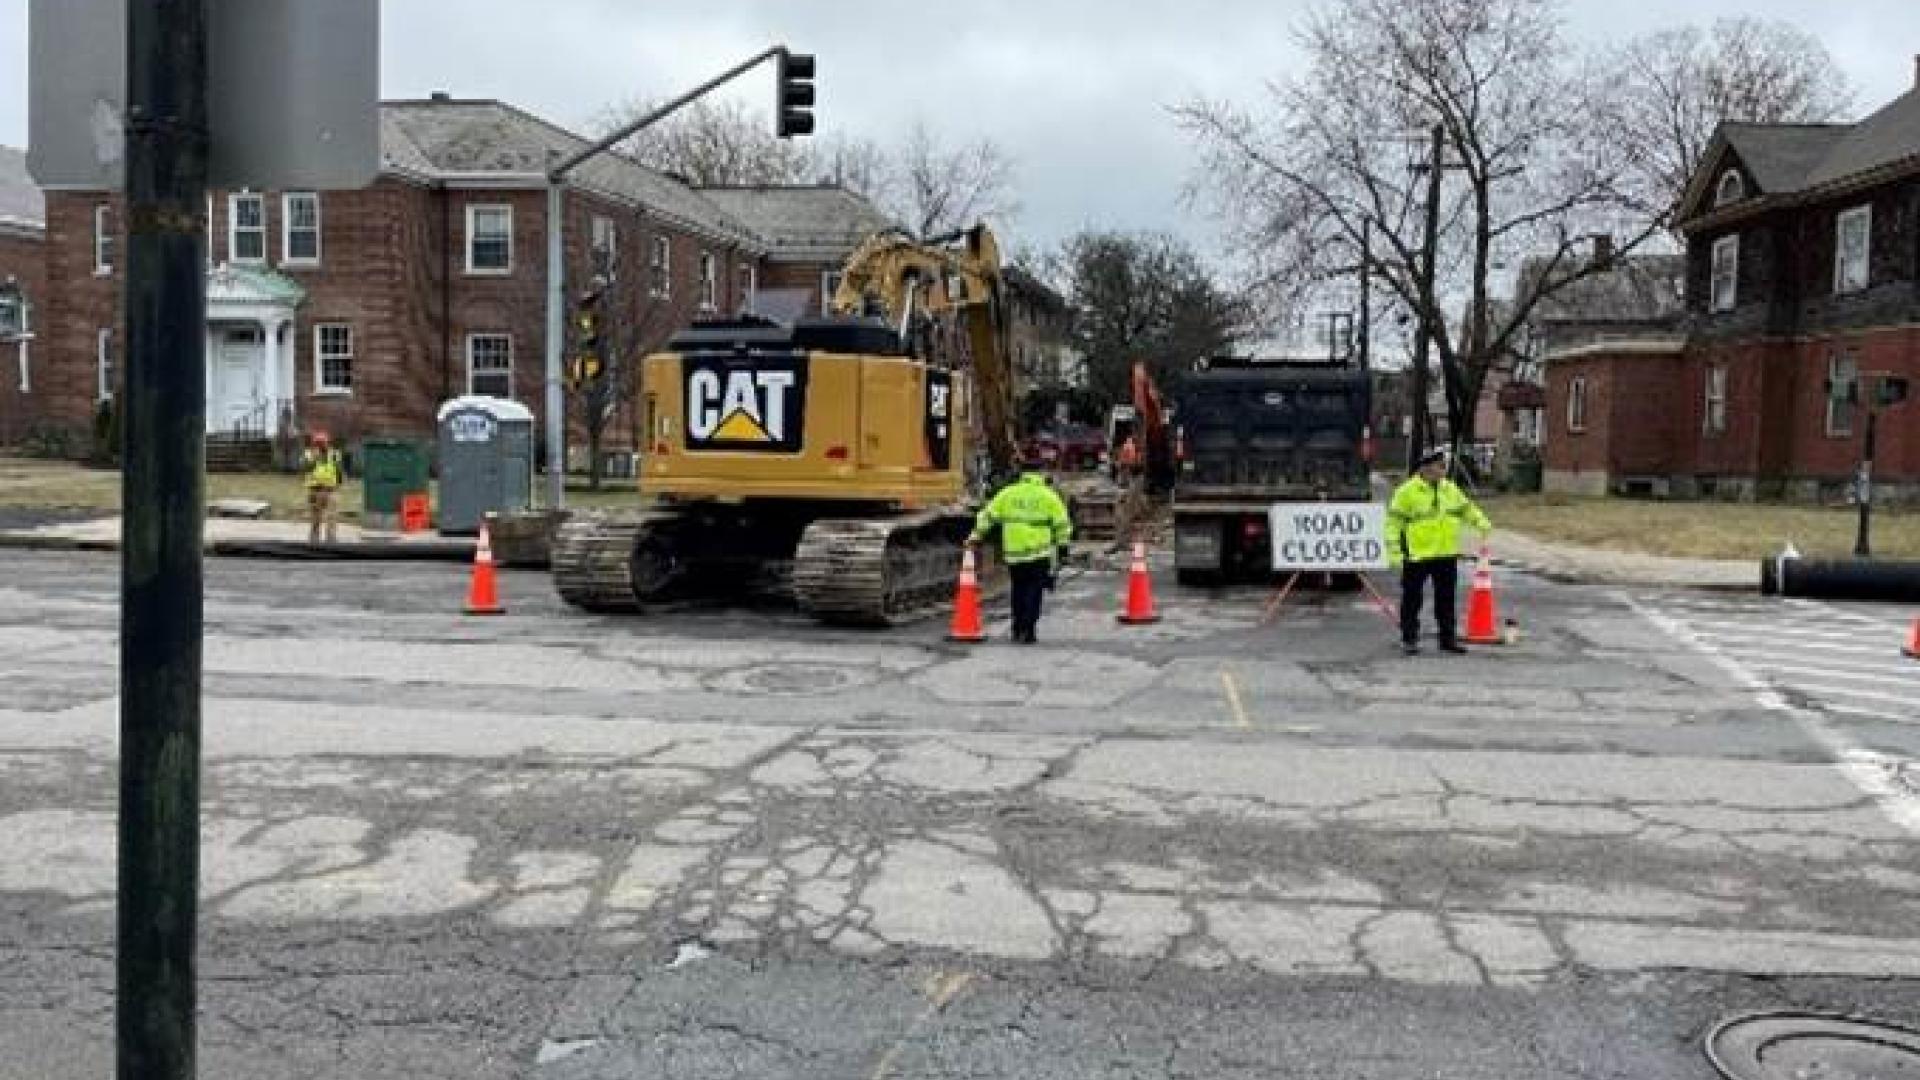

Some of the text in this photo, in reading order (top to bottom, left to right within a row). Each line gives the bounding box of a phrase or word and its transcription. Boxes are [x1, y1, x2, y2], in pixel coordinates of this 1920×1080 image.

[688, 369, 795, 441] CAT
[1293, 511, 1364, 534] ROAD
[1281, 540, 1380, 563] CLOSED
